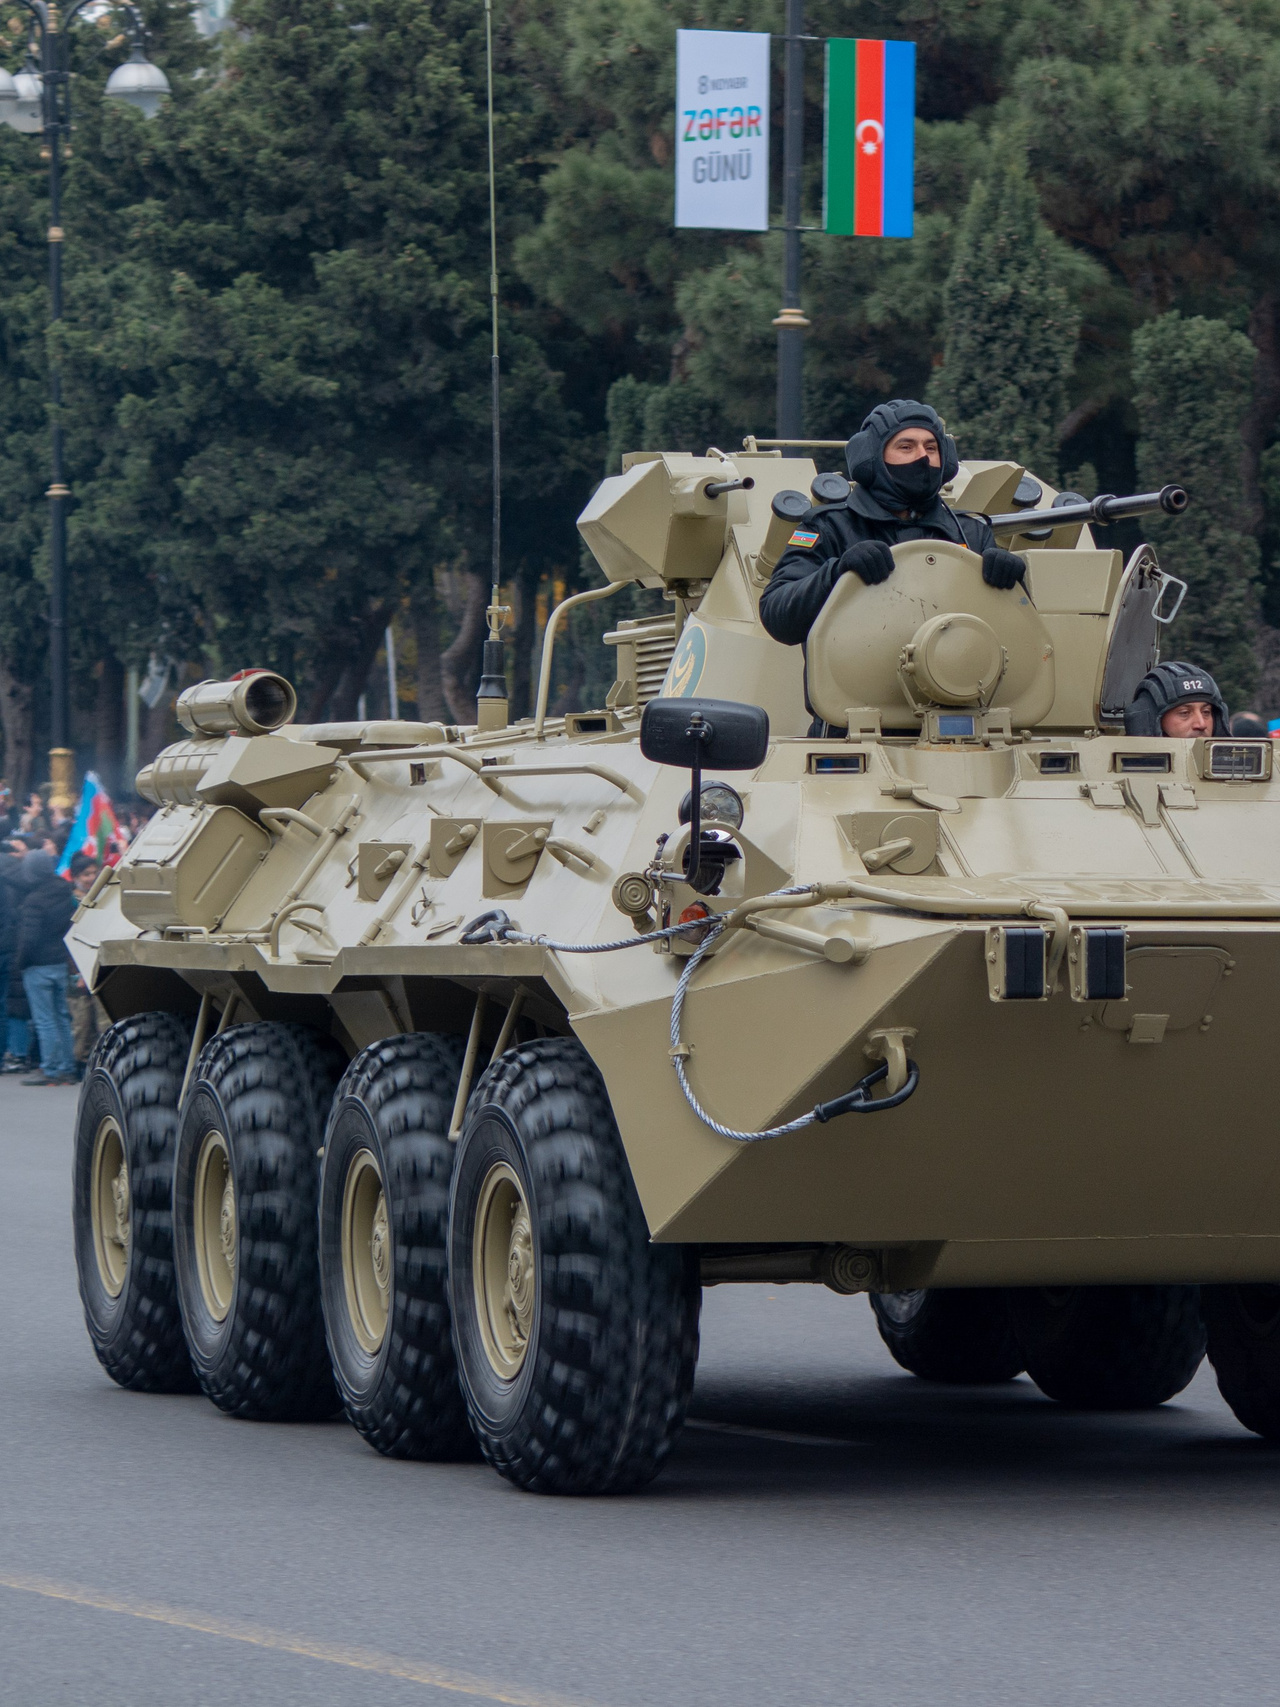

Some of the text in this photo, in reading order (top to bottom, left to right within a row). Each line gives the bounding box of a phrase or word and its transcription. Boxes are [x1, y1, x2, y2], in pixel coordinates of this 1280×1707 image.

[698, 75, 709, 95] 8
[682, 105, 762, 142] ZƏFƏR
[692, 148, 752, 184] GÜNÜ
[1183, 680, 1203, 690] 812
